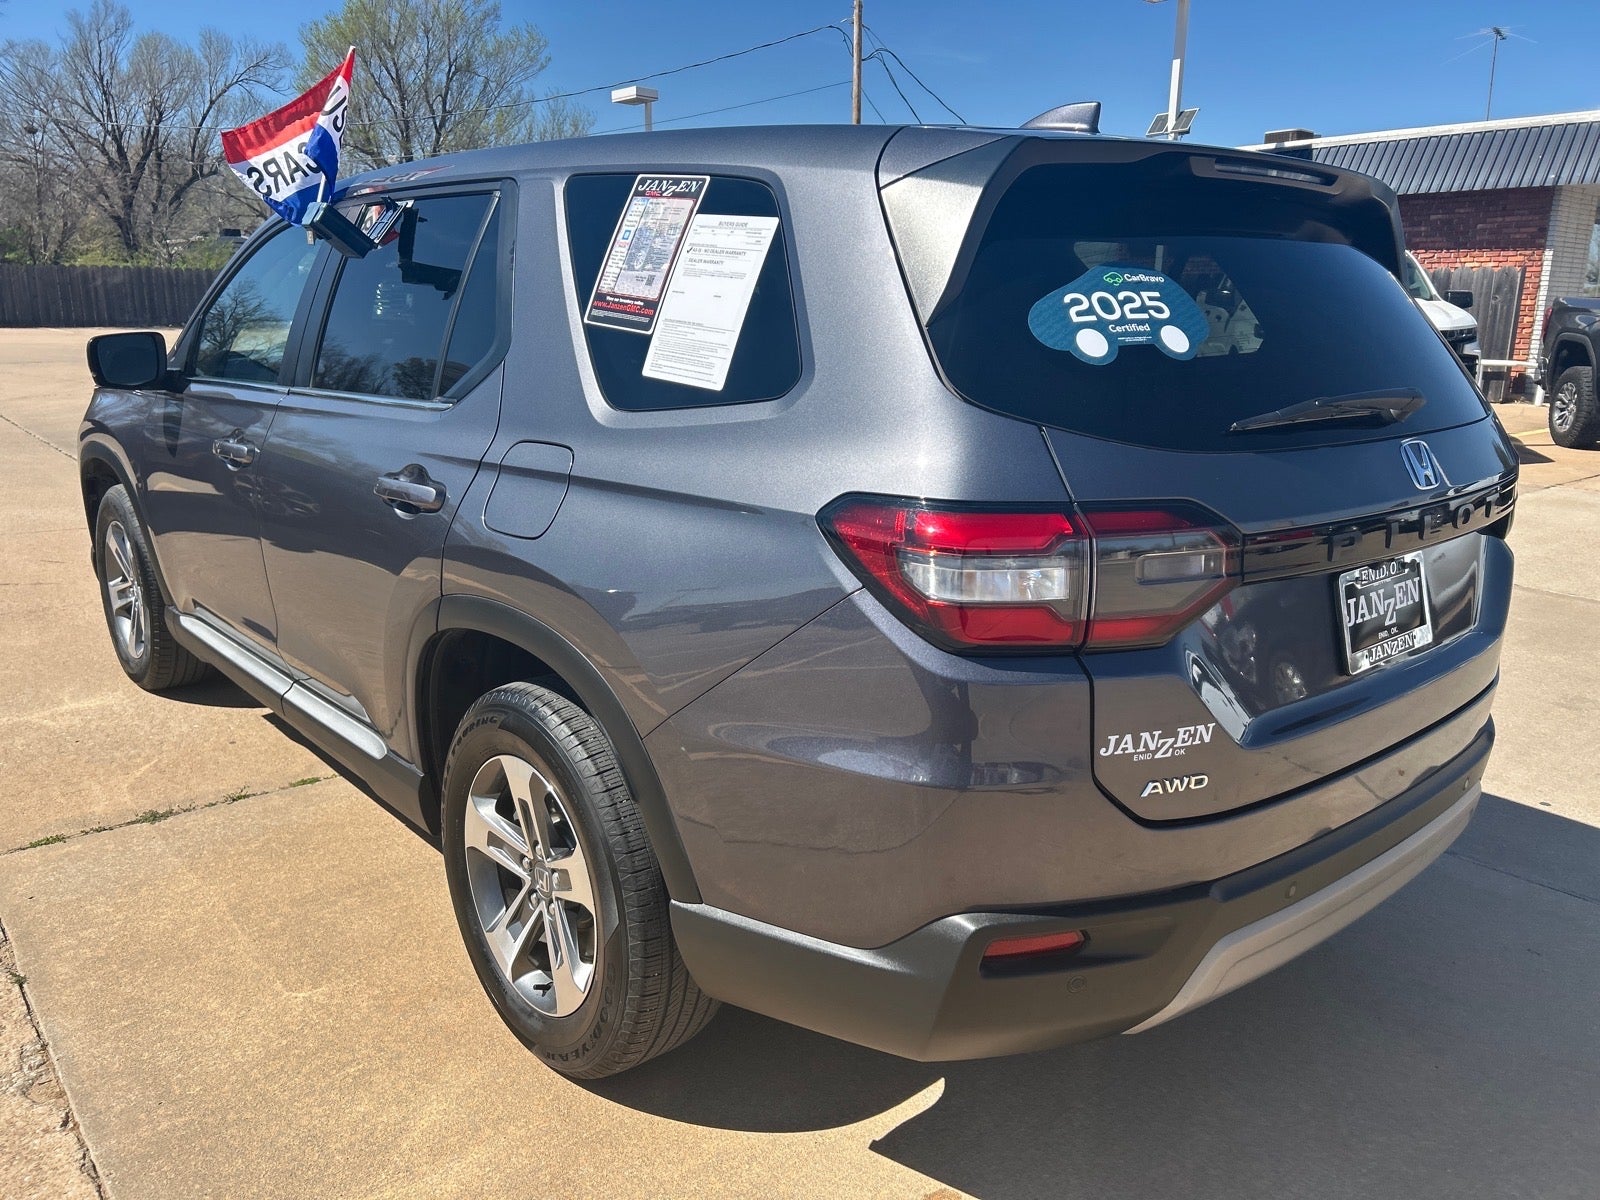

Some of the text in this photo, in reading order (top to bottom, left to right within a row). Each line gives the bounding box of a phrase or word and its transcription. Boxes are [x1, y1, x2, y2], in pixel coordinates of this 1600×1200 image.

[638, 179, 703, 197] JANZEN
[1123, 273, 1165, 282] CarBravo
[593, 300, 655, 316] www.JanzenGMC.com
[1063, 290, 1171, 323] 2025
[1108, 322, 1151, 332] Certified
[1327, 494, 1499, 562] PILOT
[1346, 576, 1420, 628] JANZEN
[1369, 633, 1414, 663] JANZEN
[1100, 722, 1216, 759] JANZEN
[1133, 748, 1186, 761] ENID OK
[1140, 774, 1209, 798] AWD
